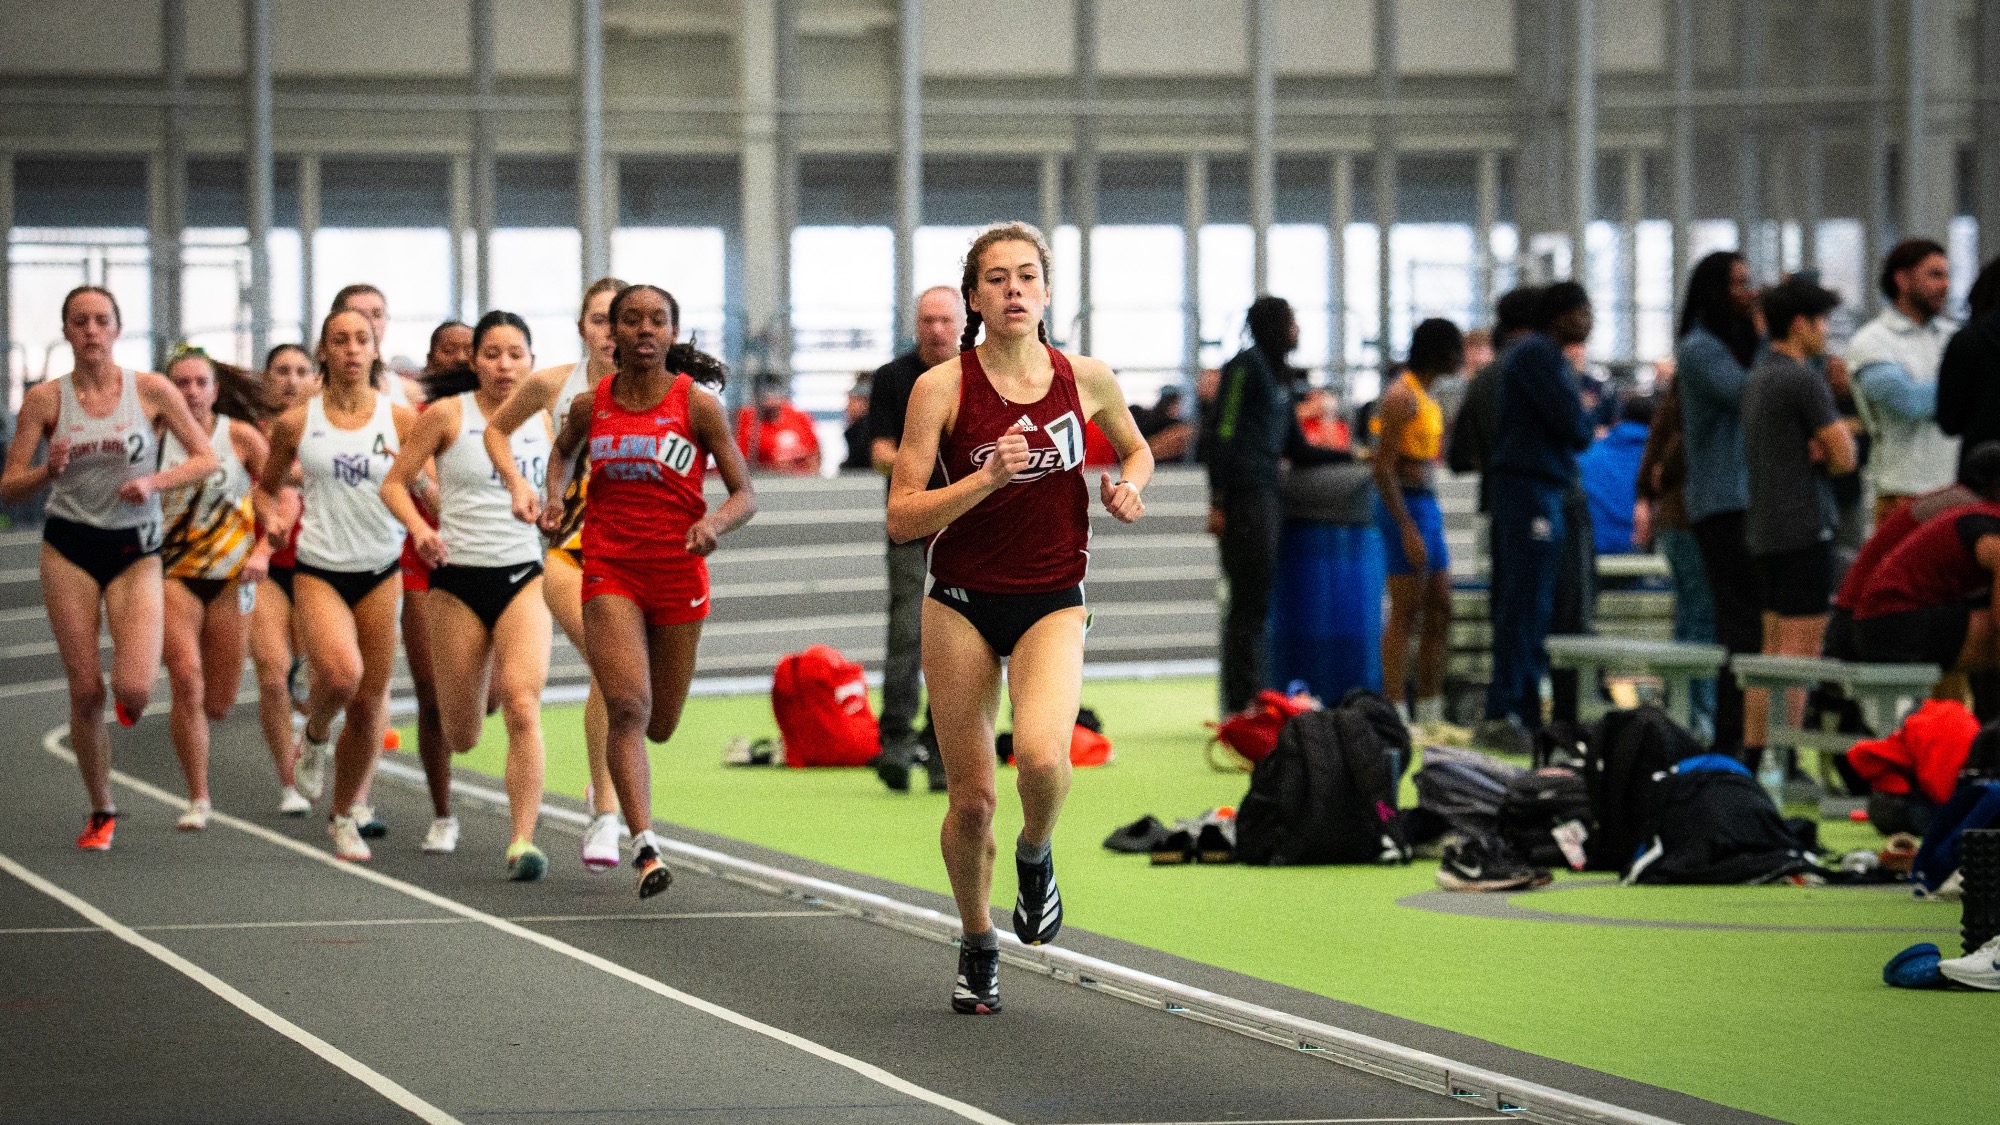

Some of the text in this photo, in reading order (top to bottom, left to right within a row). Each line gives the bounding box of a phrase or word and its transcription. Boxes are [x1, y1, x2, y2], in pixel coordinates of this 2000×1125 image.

[128, 433, 145, 463] 2
[372, 433, 389, 459] 4
[665, 437, 693, 471] 10
[1049, 417, 1076, 464] 7
[532, 457, 546, 488] 8
[140, 520, 159, 548] 2
